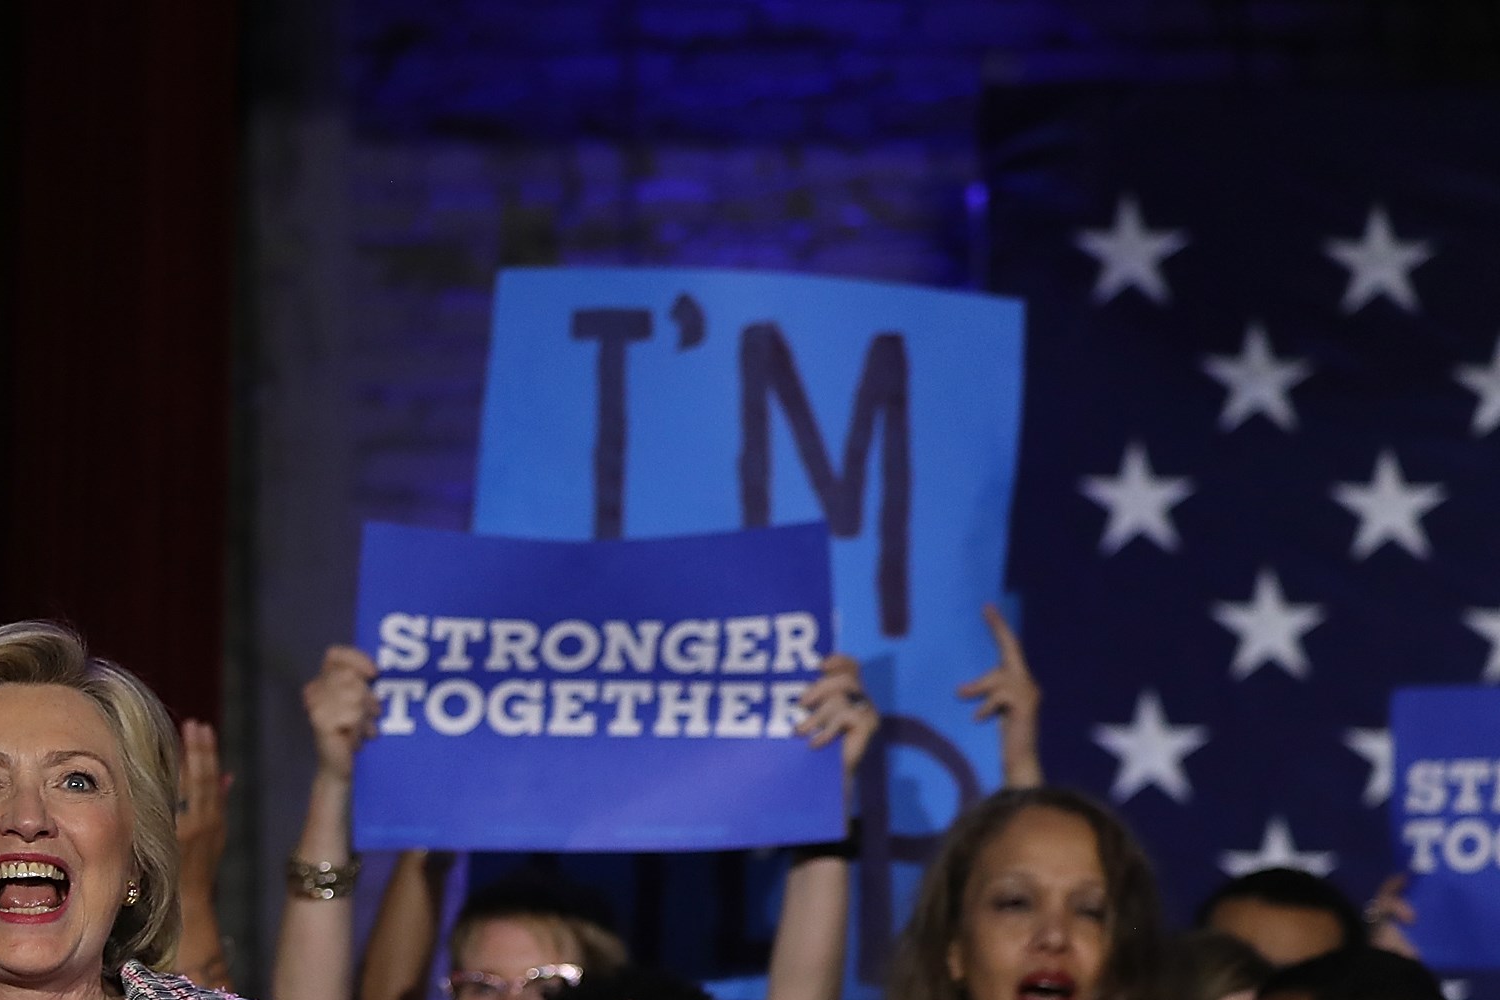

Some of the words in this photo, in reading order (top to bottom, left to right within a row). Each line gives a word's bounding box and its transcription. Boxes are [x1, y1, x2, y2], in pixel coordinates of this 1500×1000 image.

[569, 293, 909, 639] I'M
[377, 612, 824, 673] STRONGER
[1404, 759, 1500, 814] ST
[1402, 819, 1500, 874] TO
